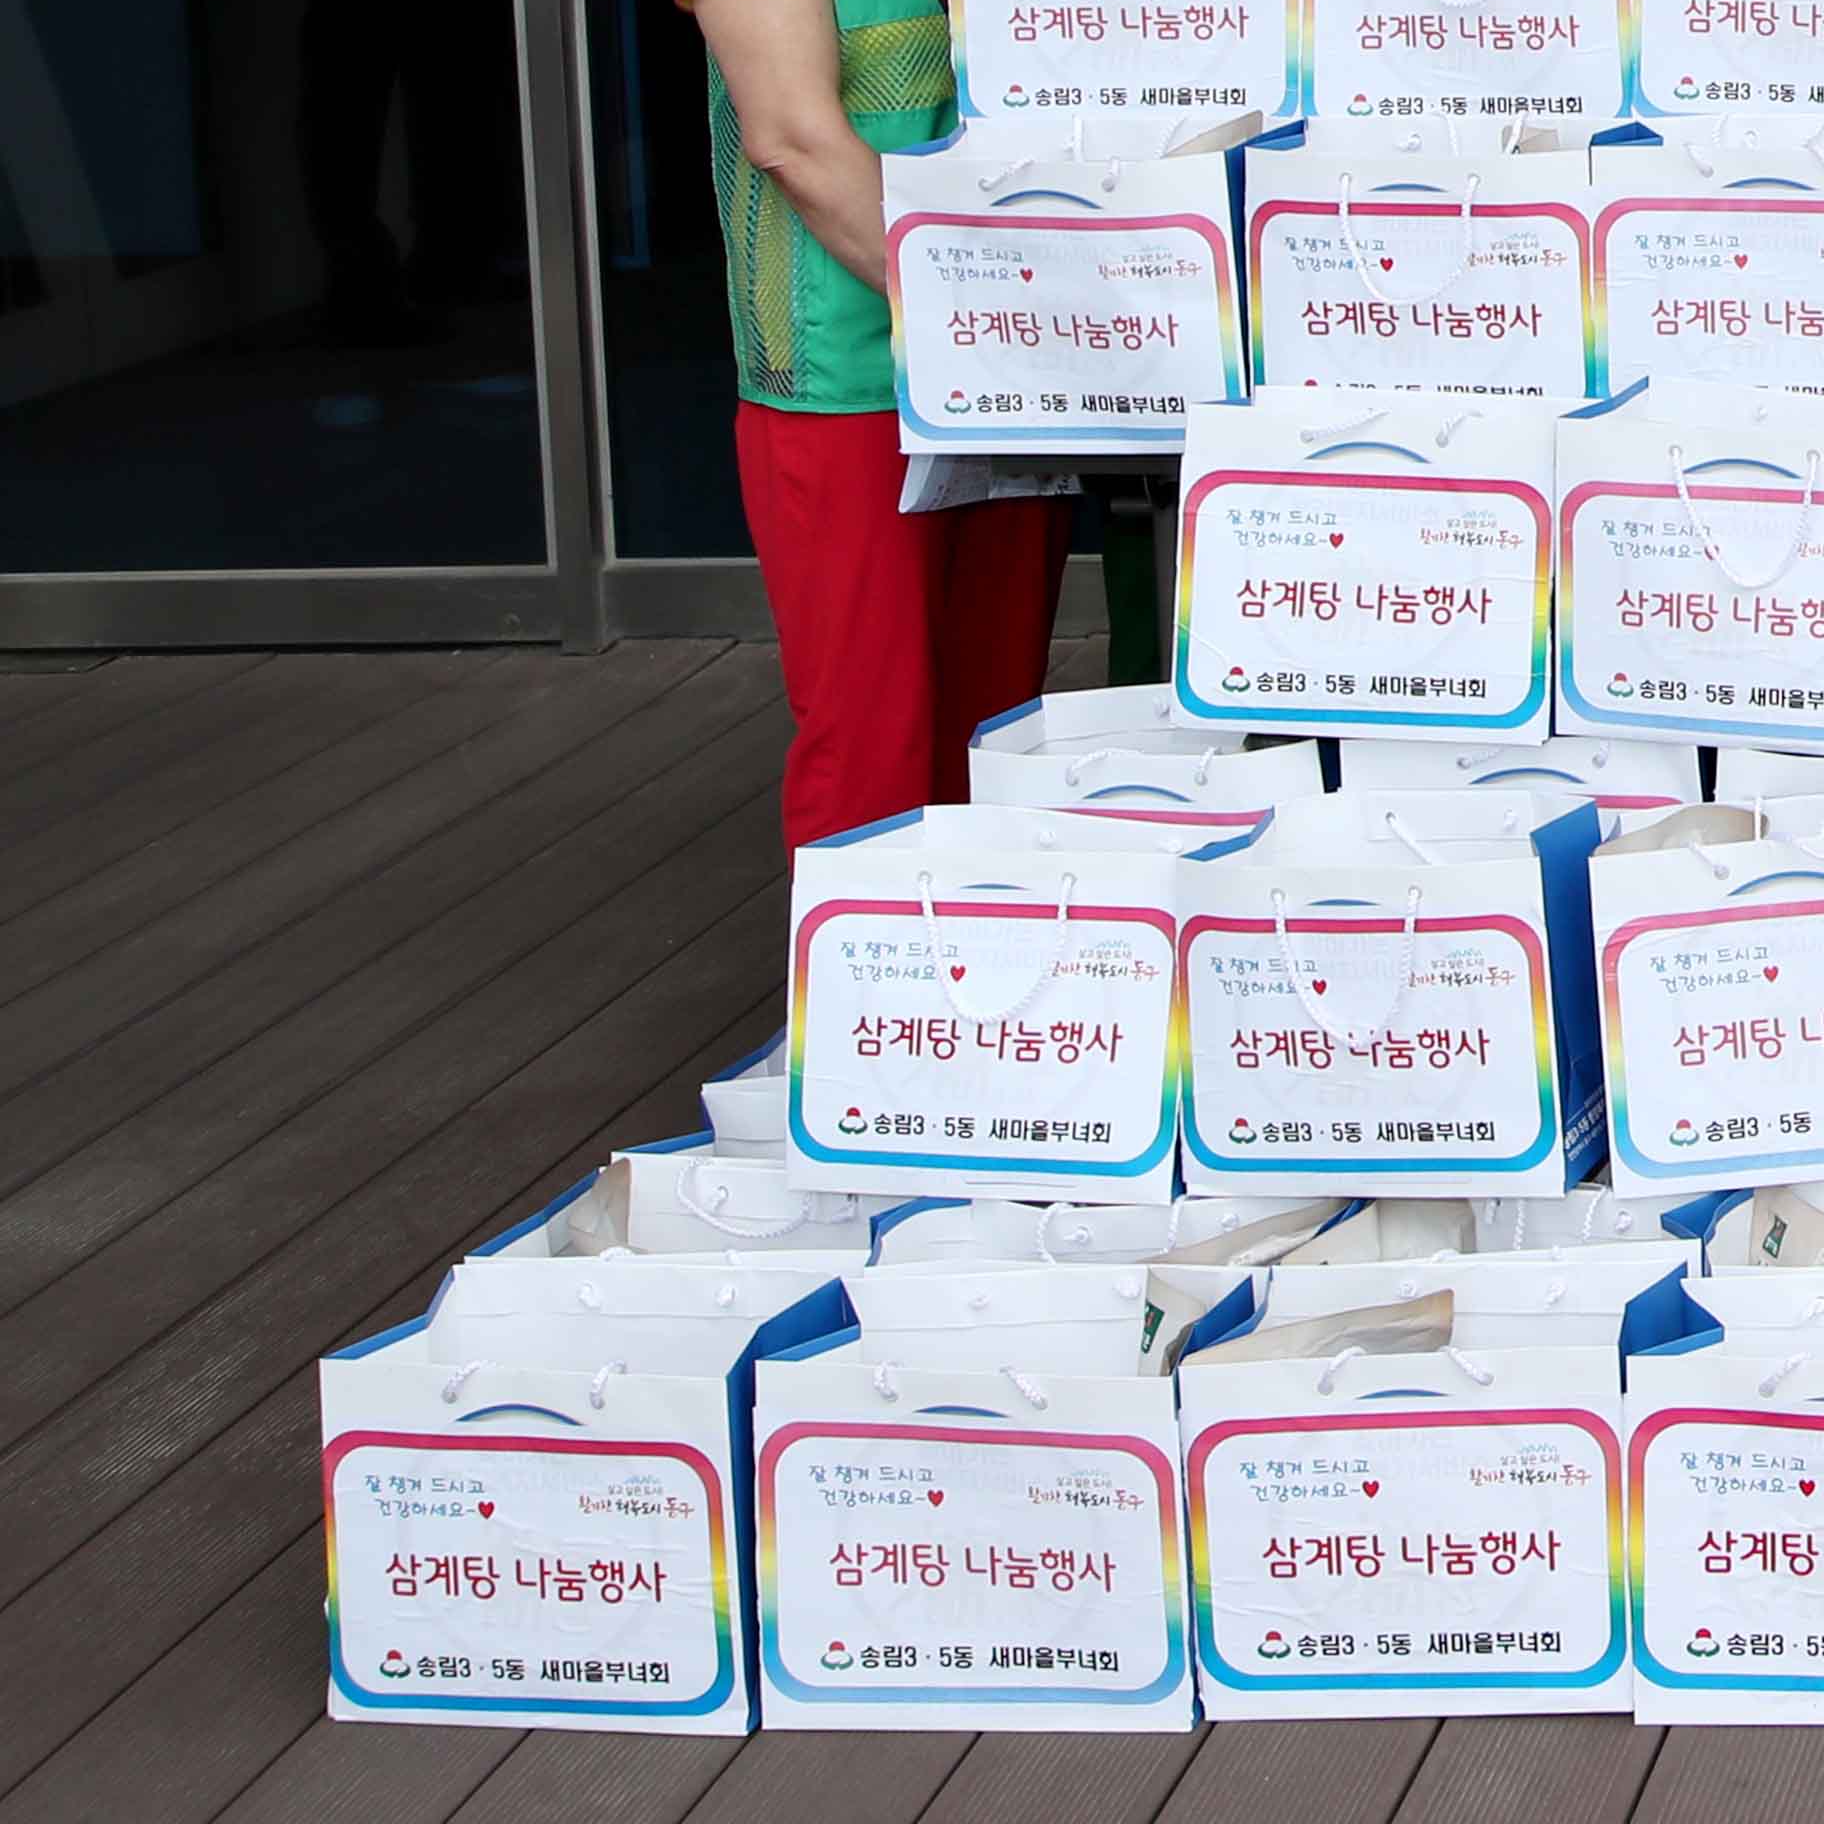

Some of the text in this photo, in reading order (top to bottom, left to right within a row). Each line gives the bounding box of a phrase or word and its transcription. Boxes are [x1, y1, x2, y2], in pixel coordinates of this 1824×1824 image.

[1010, 5, 1250, 42] 삼계탕 나눔행사
[1359, 15, 1580, 51] 삼계탕 나눔행사
[1686, 0, 1777, 35] 삼계탕
[948, 312, 1179, 351] 삼계탕 나눔행사
[1303, 301, 1543, 340] 삼계탕 나눔행사
[1653, 300, 1751, 337] 삼계탕
[1236, 580, 1494, 625] 삼계탕 나눔행사
[1617, 592, 1720, 633] 삼계탕
[1369, 675, 1486, 699] 새마을부녀회
[850, 1015, 1125, 1065] 삼계탕 나눔행사
[1230, 1029, 1336, 1070] 삼계탕
[1674, 1018, 1788, 1067] 삼계탕
[830, 1543, 1118, 1593] 삼계탕 나눔행사
[1262, 1529, 1563, 1579] 삼계탕 나눔행사
[1697, 1530, 1821, 1577] 삼계탕
[385, 1553, 669, 1604] 삼계탕 나눔행사
[539, 1659, 670, 1685] 새마을부녀회
